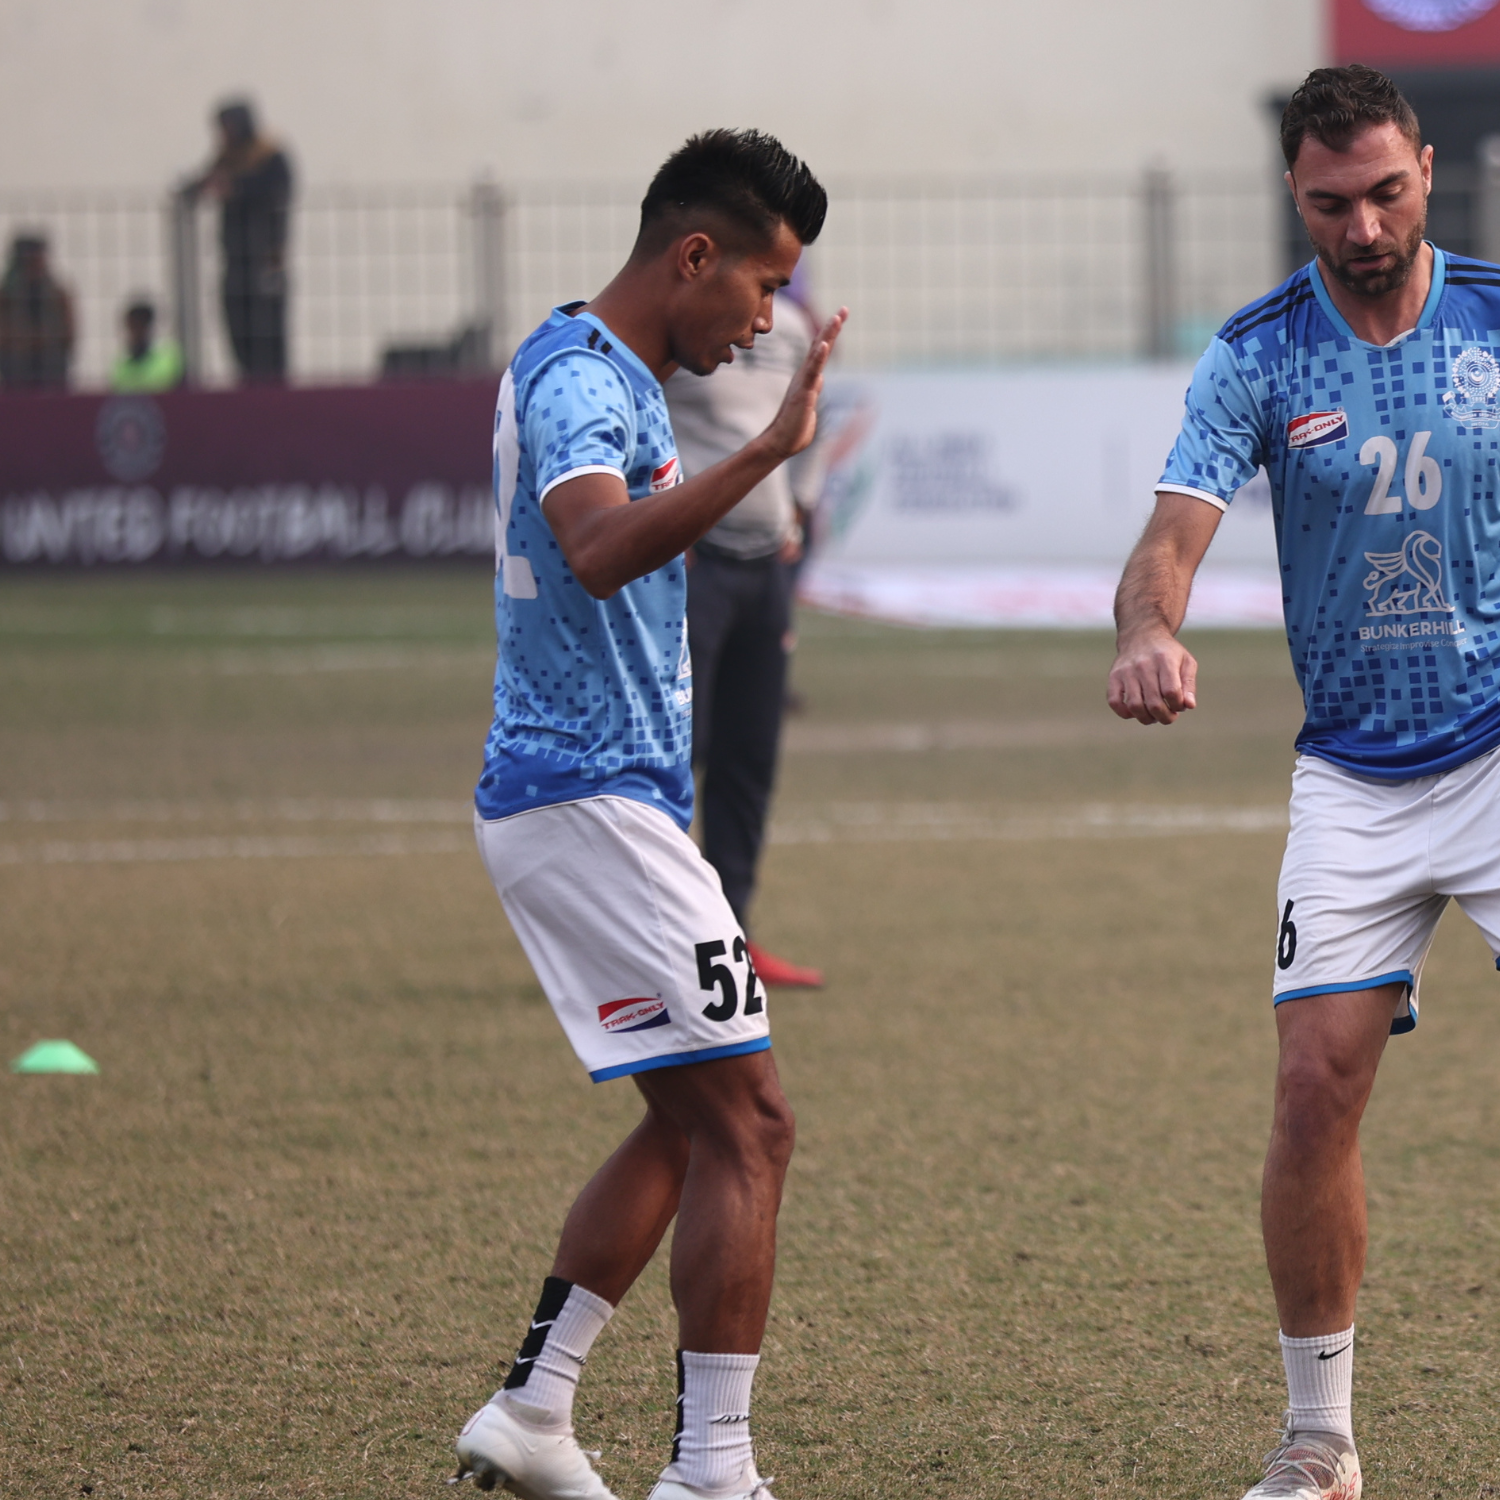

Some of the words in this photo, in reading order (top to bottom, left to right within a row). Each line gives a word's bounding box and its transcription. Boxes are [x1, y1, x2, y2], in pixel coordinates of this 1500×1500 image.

[1290, 415, 1344, 443] RAK-ONLY
[1359, 431, 1442, 515] 26
[2, 487, 166, 562] UNITED
[170, 484, 398, 560] FOOTBALL
[401, 480, 495, 558] CLU
[1358, 620, 1466, 640] BUNKERHILL
[1400, 640, 1440, 650] Improvise
[1277, 899, 1297, 970] 6
[694, 935, 763, 1022] 52
[601, 1001, 664, 1030] TRAK-ONLY
